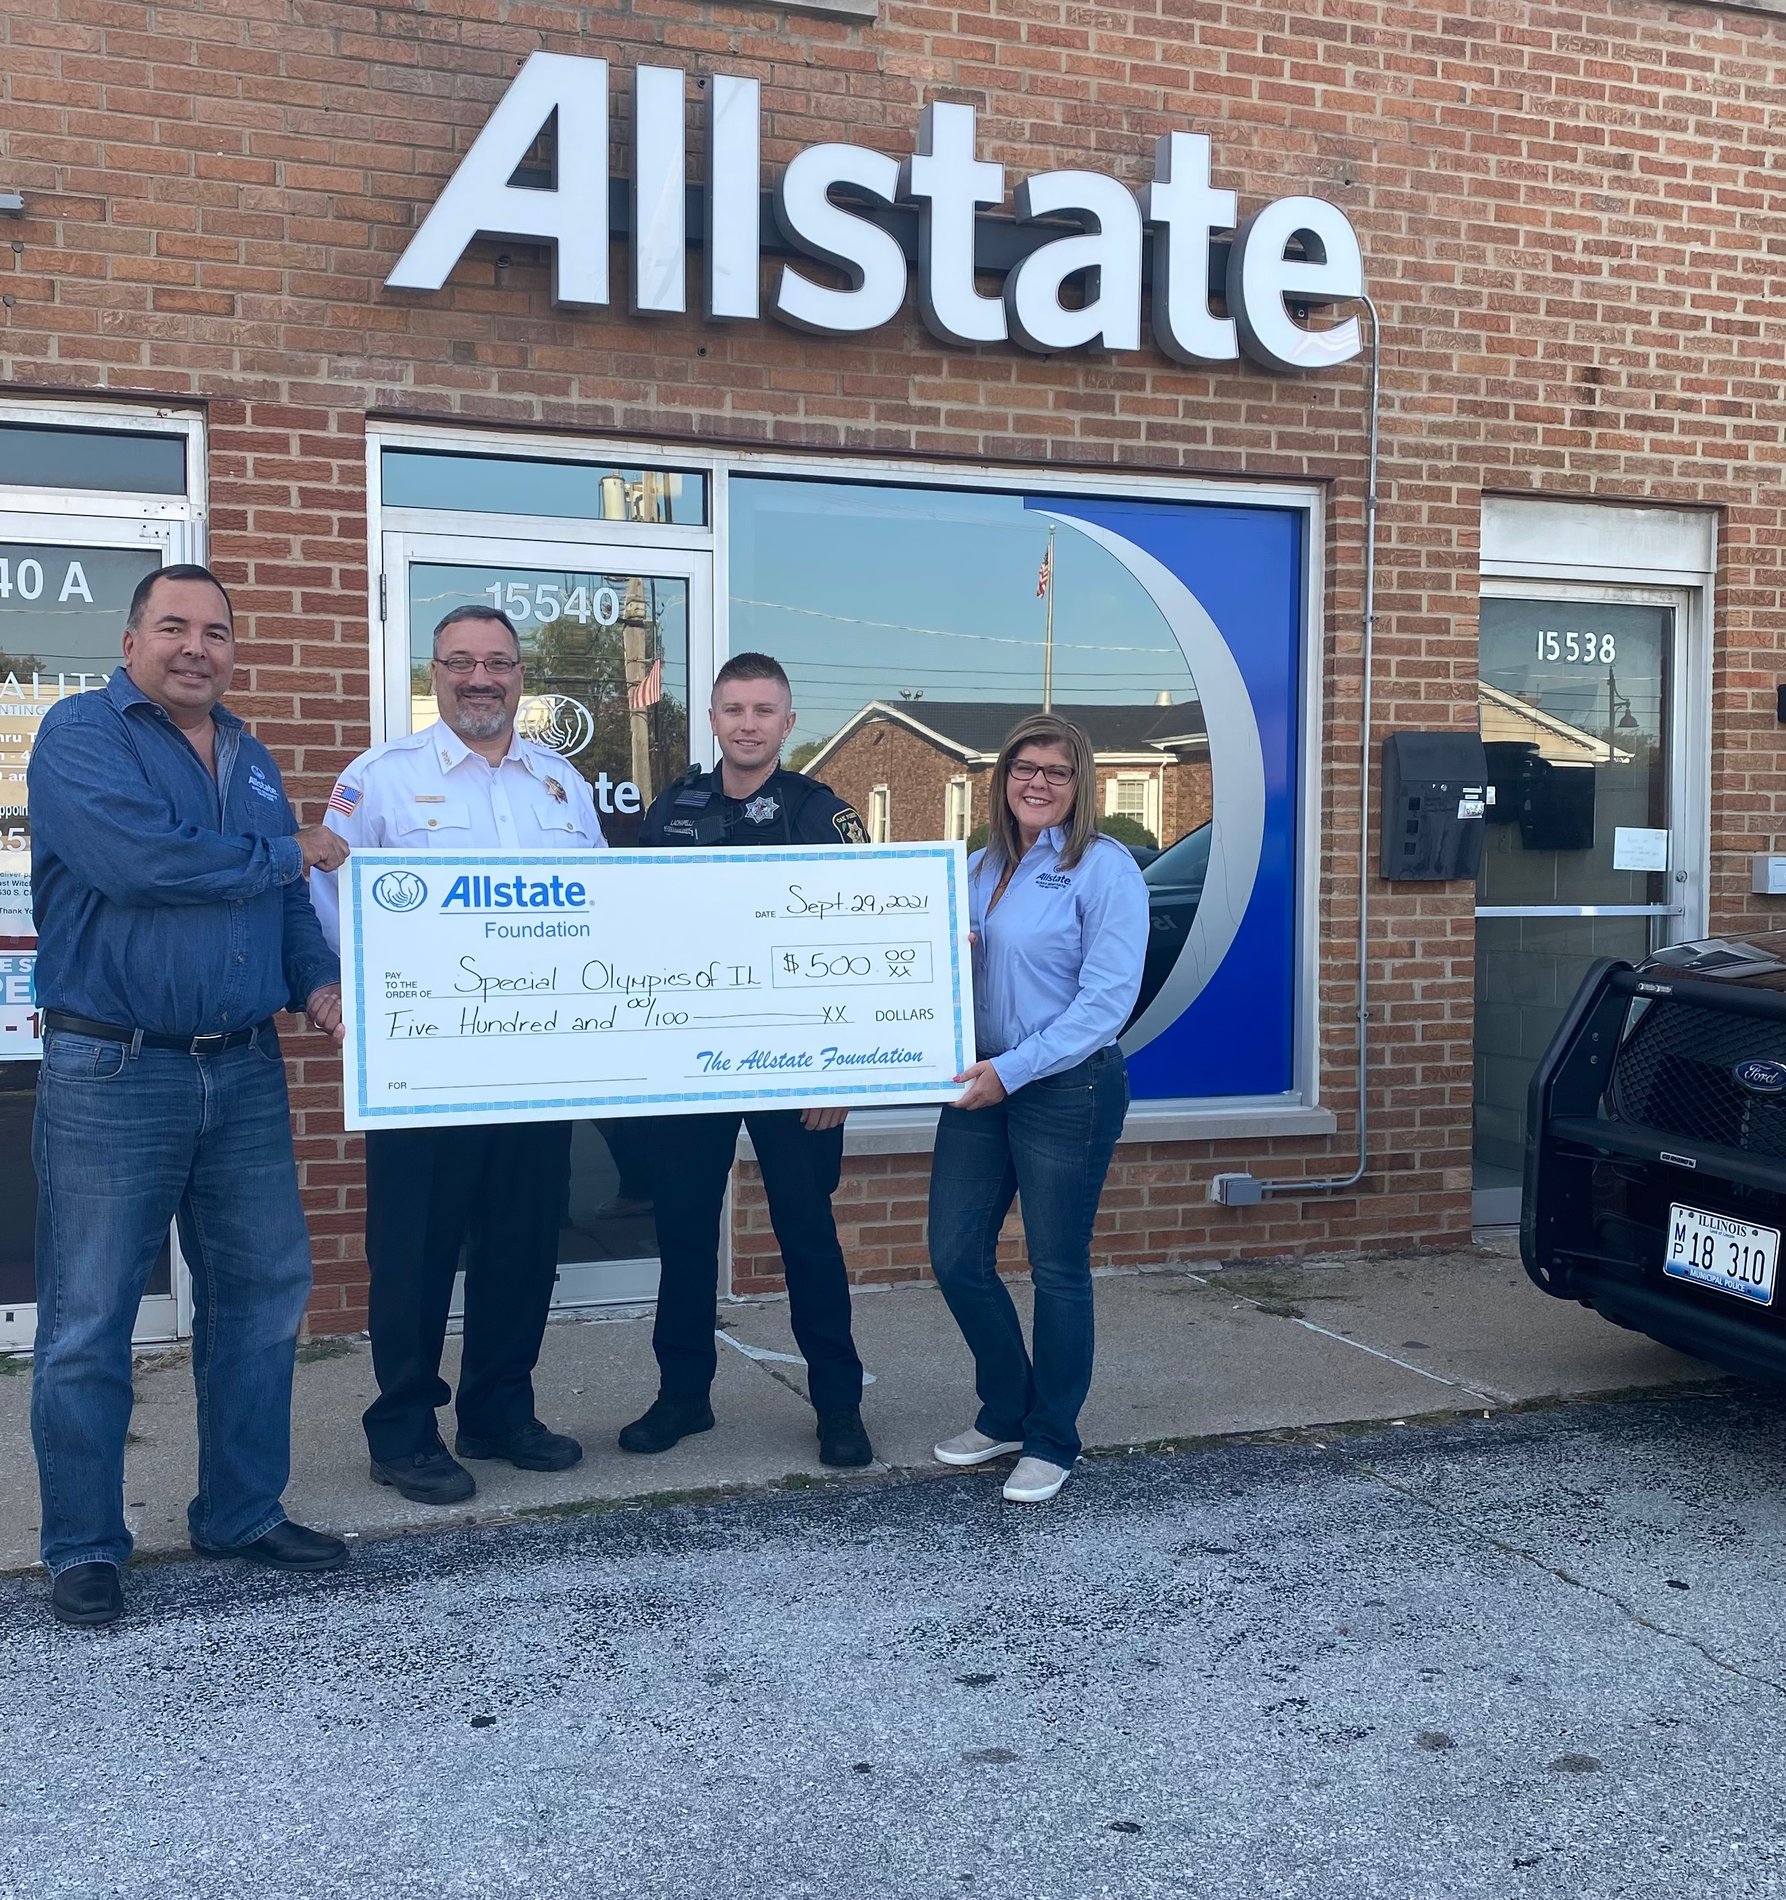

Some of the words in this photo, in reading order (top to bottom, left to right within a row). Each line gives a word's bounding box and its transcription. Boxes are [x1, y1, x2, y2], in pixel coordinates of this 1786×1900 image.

[384, 49, 1366, 370] Allstate
[58, 561, 94, 602] A
[485, 581, 620, 626] 15540
[1537, 630, 1616, 664] 15538
[0, 671, 112, 700] ALIT
[1035, 872, 1072, 886] Allstate
[441, 875, 587, 909] Allstate
[755, 910, 777, 919] DATE
[485, 921, 591, 939] Foundation
[385, 971, 402, 980] PAY
[385, 980, 398, 989] TO
[399, 980, 418, 989] THE
[454, 956, 558, 1003] Special
[727, 965, 762, 987] IL
[385, 990, 416, 999] ORDER
[416, 989, 432, 998] OF
[385, 1010, 440, 1038] Five
[460, 1006, 558, 1035] Hundred
[571, 1005, 618, 1031] and
[875, 1008, 935, 1022] DOLLARS
[696, 1049, 732, 1073] The
[736, 1049, 813, 1072] Allstate
[819, 1046, 924, 1071] Foundation
[387, 1081, 407, 1090] FOR
[1744, 1063, 1780, 1084] Ford
[1698, 1214, 1748, 1238] ILLINOIS
[1688, 1231, 1715, 1270] 18
[1726, 1242, 1766, 1286] 310
[1689, 1269, 1723, 1286] MUNICIPAL
[1724, 1279, 1746, 1293] POLICE
